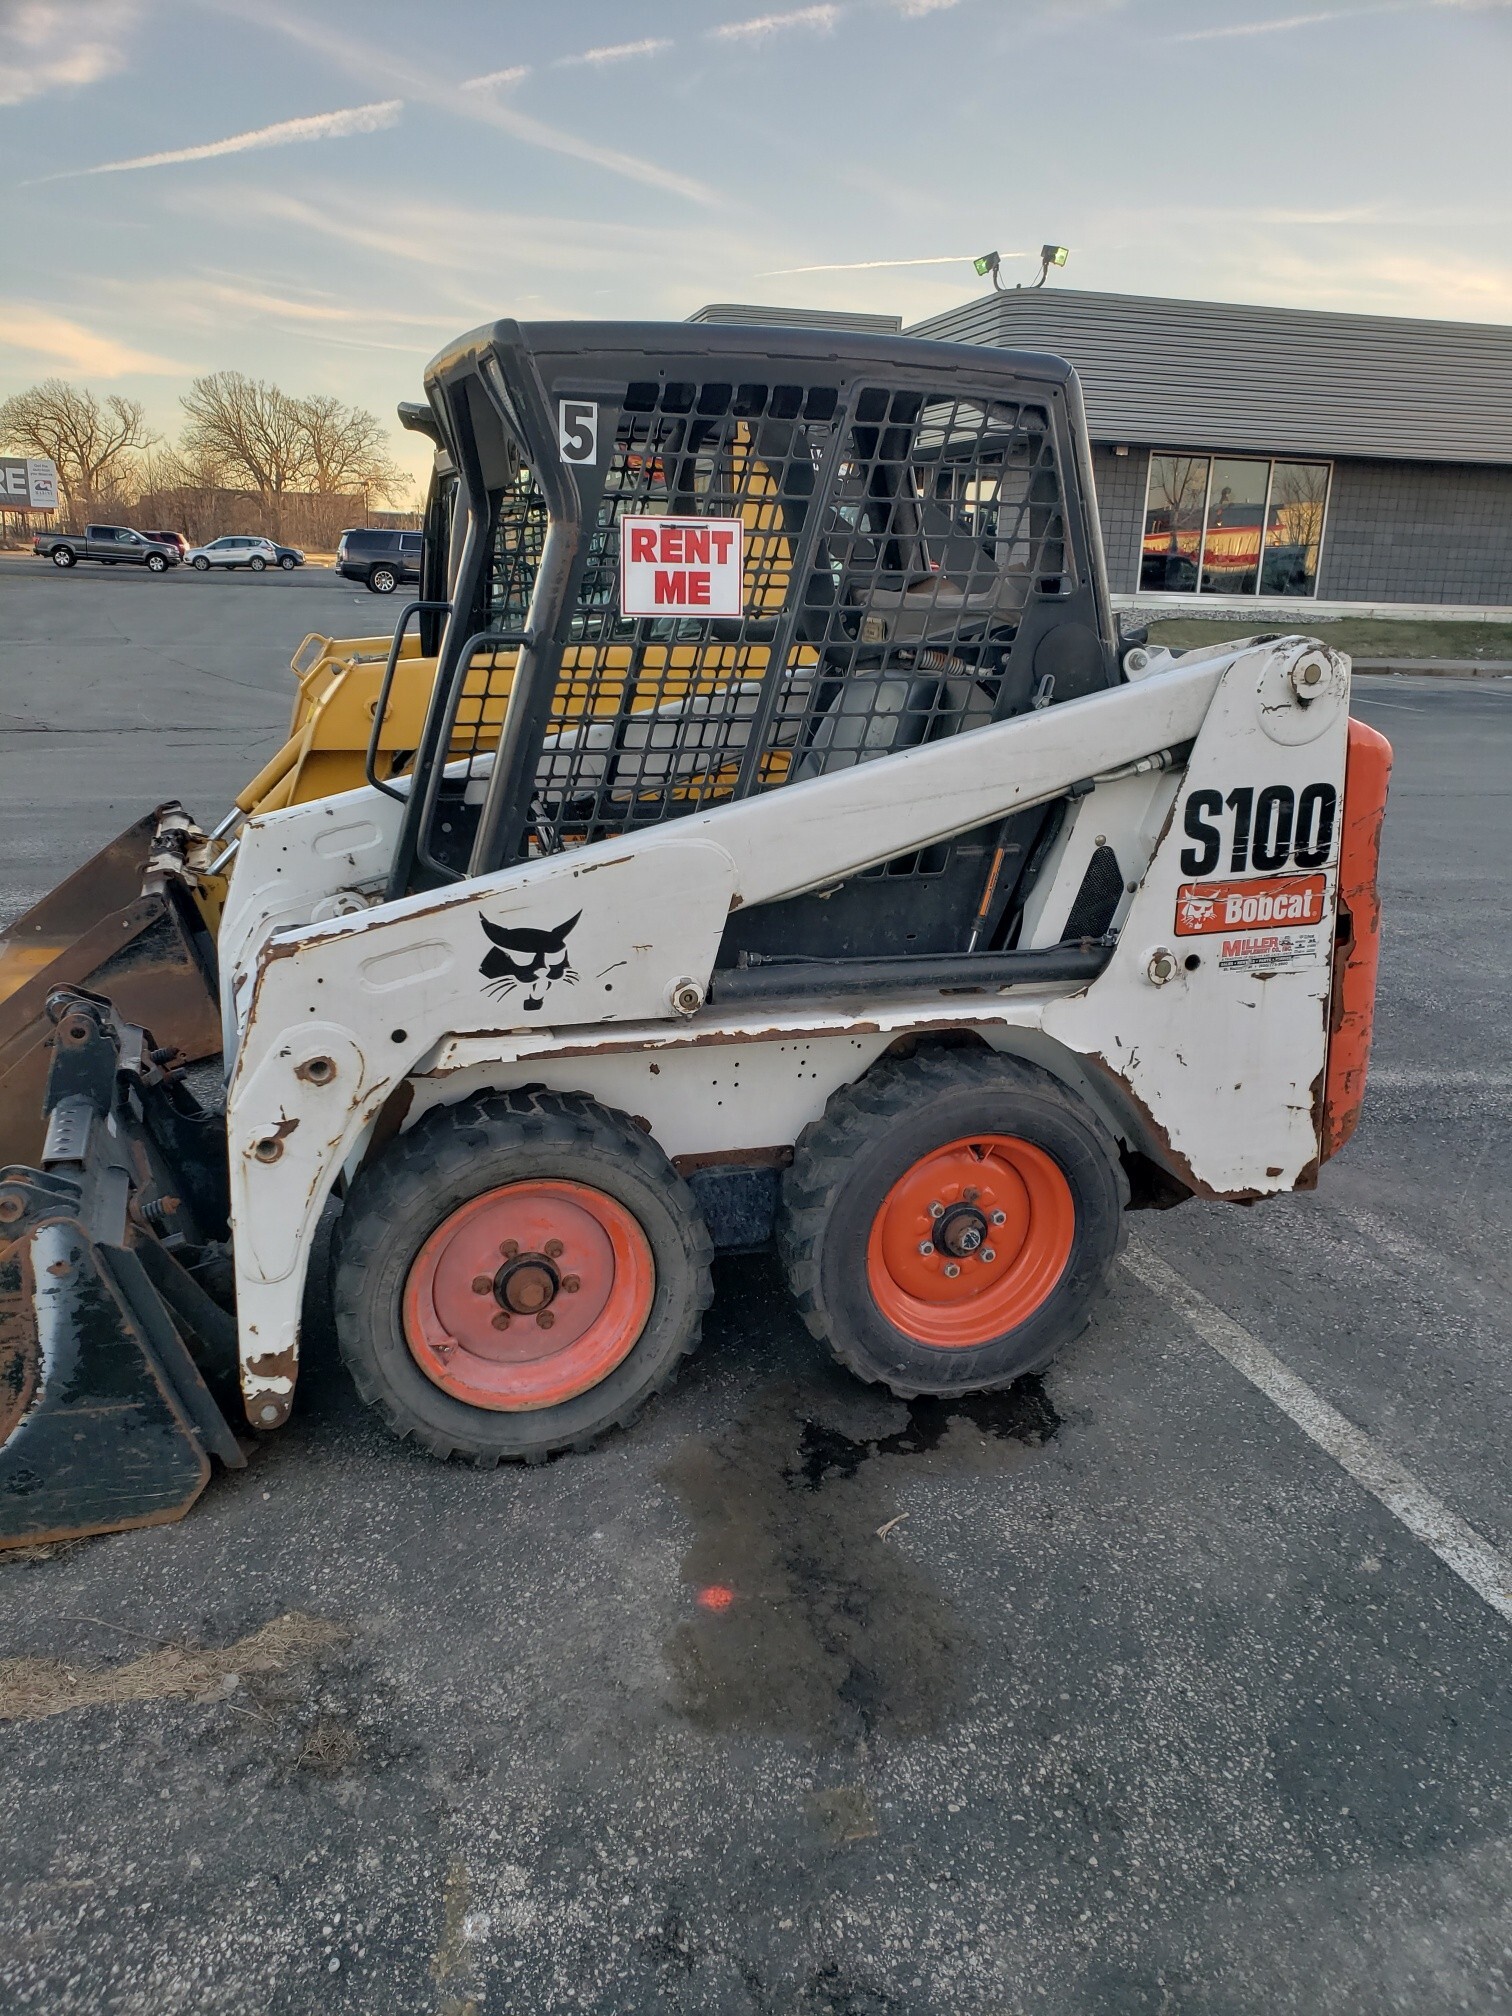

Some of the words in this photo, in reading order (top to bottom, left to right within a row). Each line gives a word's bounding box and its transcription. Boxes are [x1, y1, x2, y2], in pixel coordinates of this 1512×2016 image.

[562, 404, 594, 461] 5
[631, 528, 734, 565] RENT
[654, 570, 711, 605] ME
[1180, 783, 1337, 877] S100
[1225, 889, 1313, 924] Bobcat
[1222, 936, 1279, 957] MILLER
